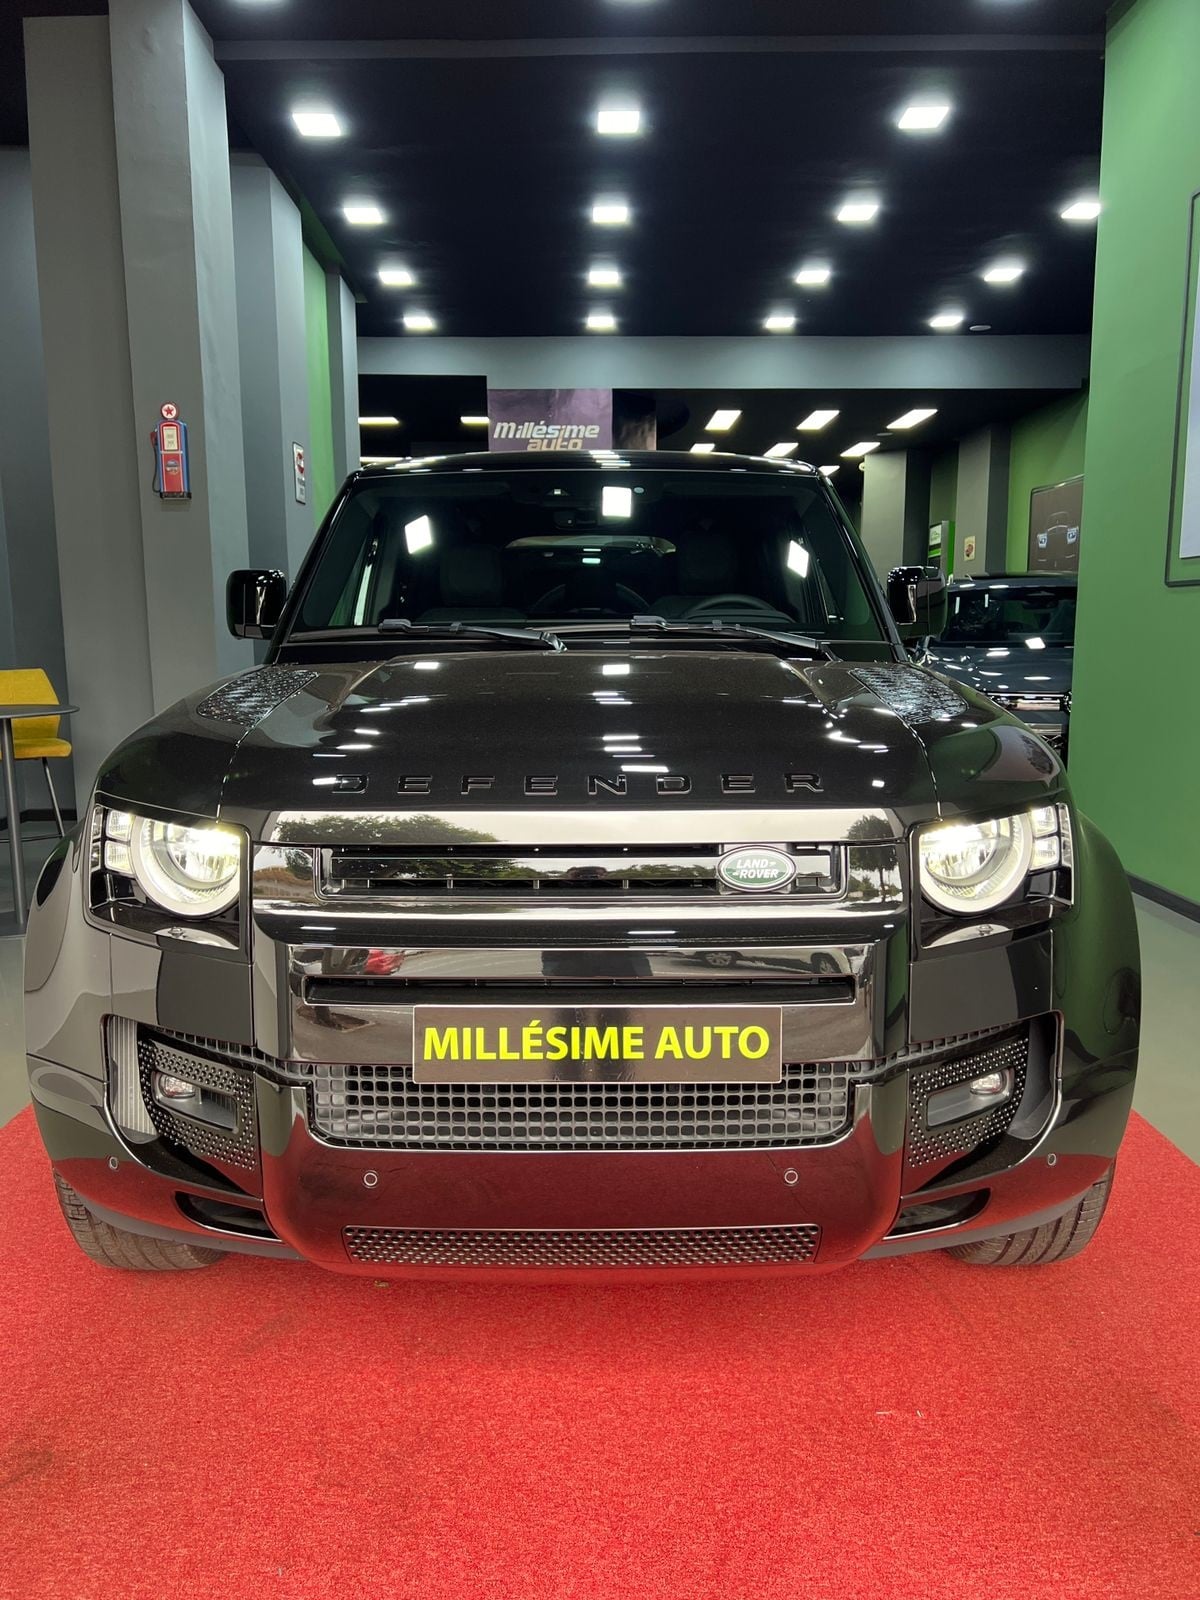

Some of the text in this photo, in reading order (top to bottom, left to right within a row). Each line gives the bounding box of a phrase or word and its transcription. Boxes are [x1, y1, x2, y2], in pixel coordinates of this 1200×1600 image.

[493, 420, 600, 439] Millésime
[526, 438, 583, 451] auto
[332, 773, 824, 795] DEFENDER
[736, 859, 769, 869] LAND
[739, 868, 779, 879] ROVER
[422, 1021, 769, 1060] MILLÉSIME AUTO
